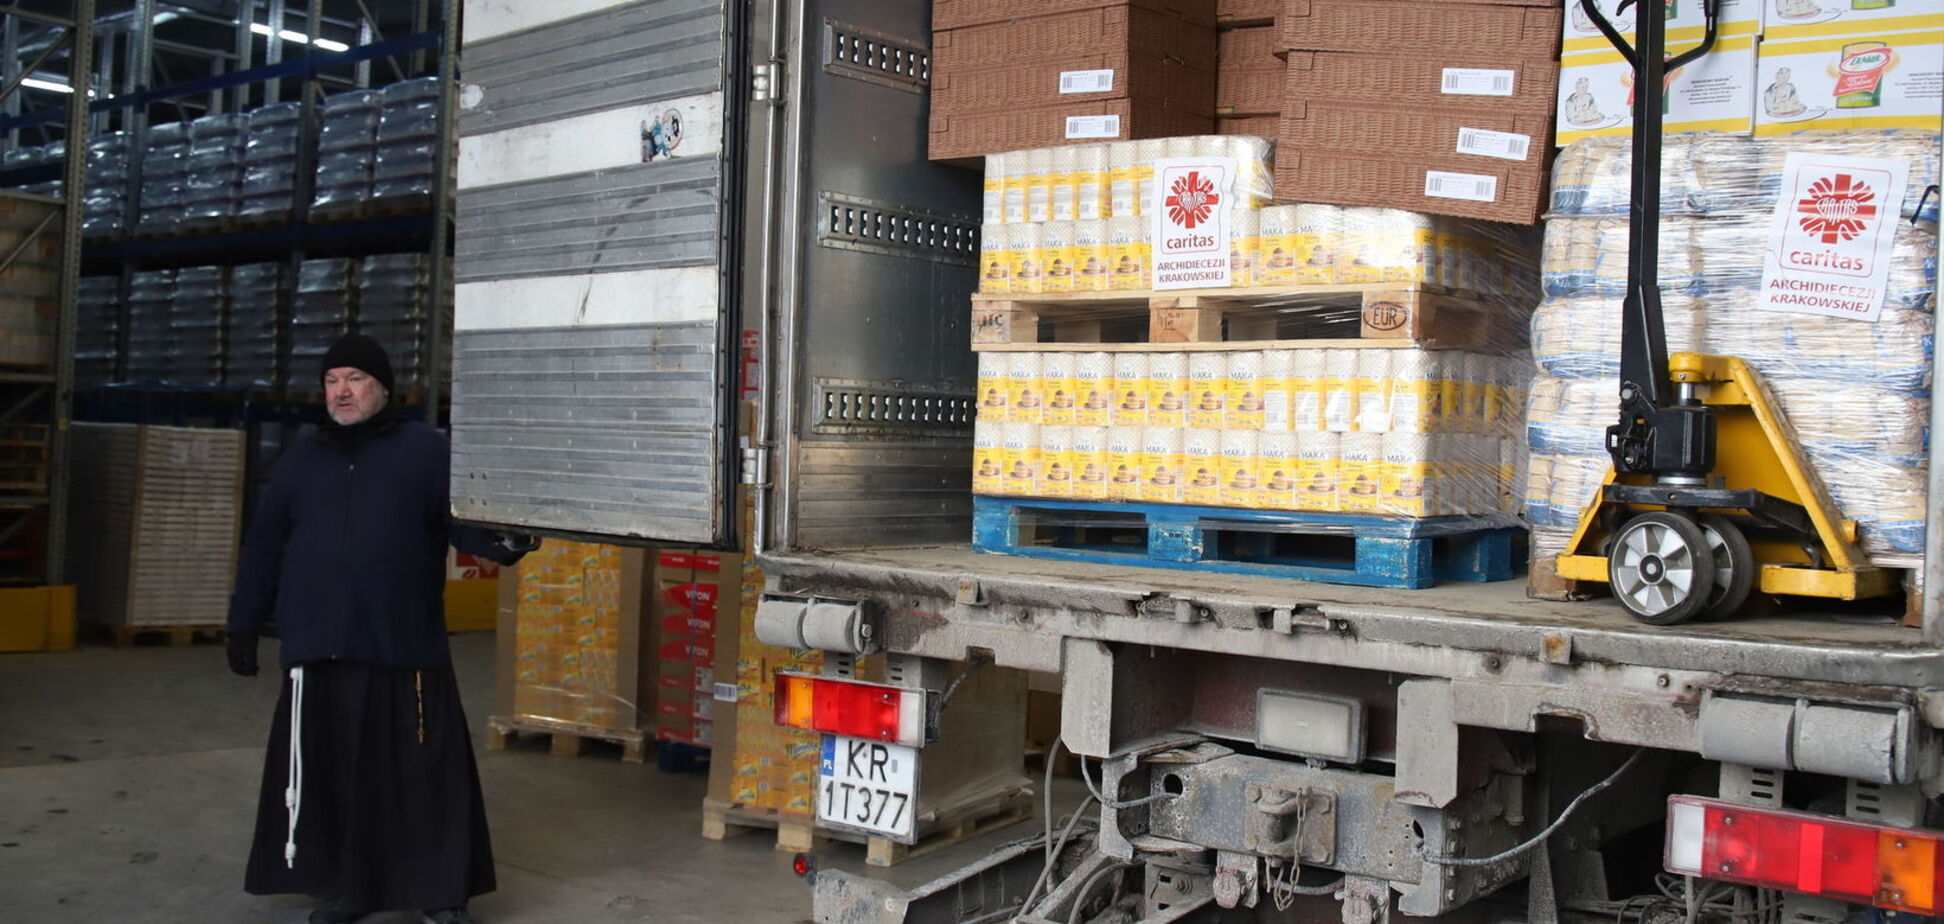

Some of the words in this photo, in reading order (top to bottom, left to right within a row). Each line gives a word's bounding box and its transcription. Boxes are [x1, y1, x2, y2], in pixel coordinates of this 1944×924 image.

[1167, 234, 1214, 249] caritas
[1157, 259, 1225, 271] ARCHIDIECEZJI
[1790, 250, 1863, 271] caritas
[1159, 271, 1224, 283] KRAKOWSKIEJ
[1770, 279, 1876, 299] ARCHIDIECEZJI
[1770, 294, 1871, 313] KRAKOWSKIEJ
[1373, 306, 1397, 326] EUR
[823, 759, 833, 770] PL
[847, 740, 889, 783] KR
[826, 780, 909, 829] 1T377
